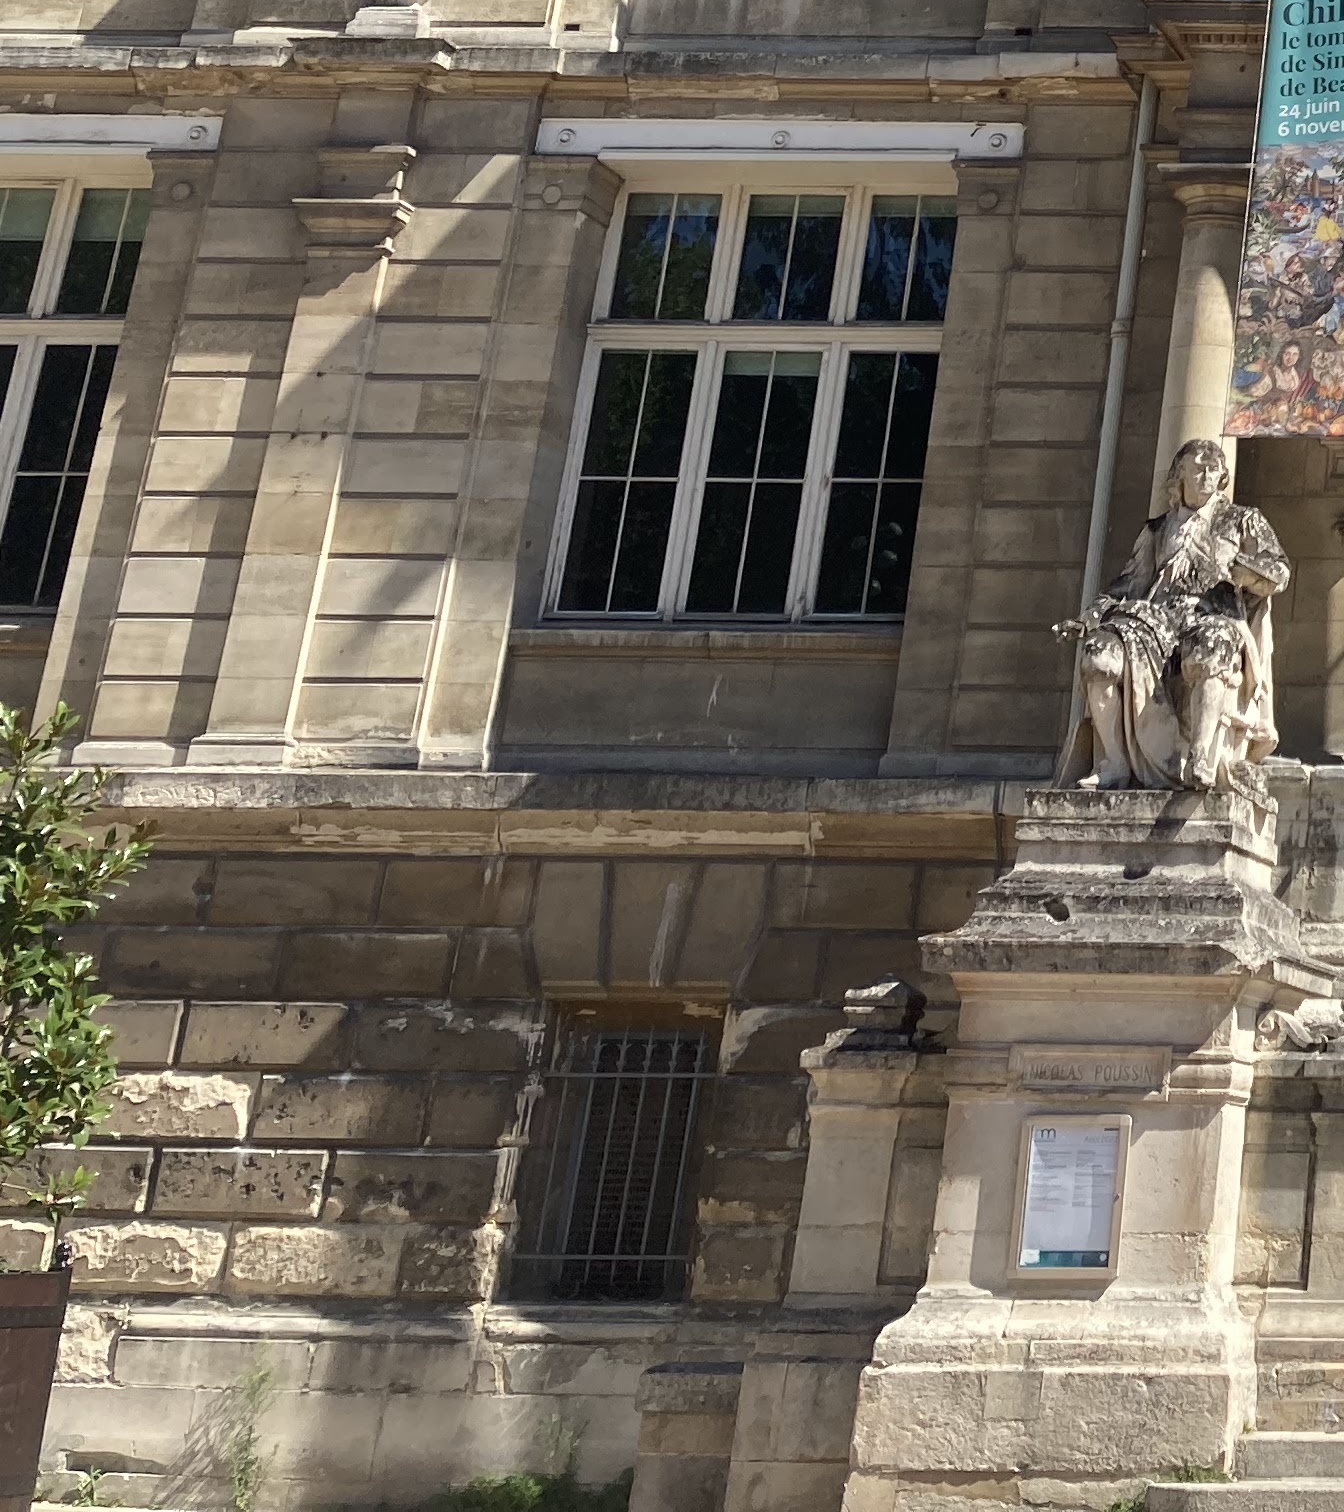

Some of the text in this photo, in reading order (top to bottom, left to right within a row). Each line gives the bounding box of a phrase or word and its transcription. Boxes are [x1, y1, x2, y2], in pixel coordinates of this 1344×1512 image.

[1281, 31, 1301, 51] le
[1280, 54, 1307, 74] de
[1279, 77, 1307, 98] de
[1278, 98, 1340, 120] 24 juin
[1277, 120, 1290, 137] 6
[1030, 1064, 1152, 1082] NICOLAS POUSSIN
